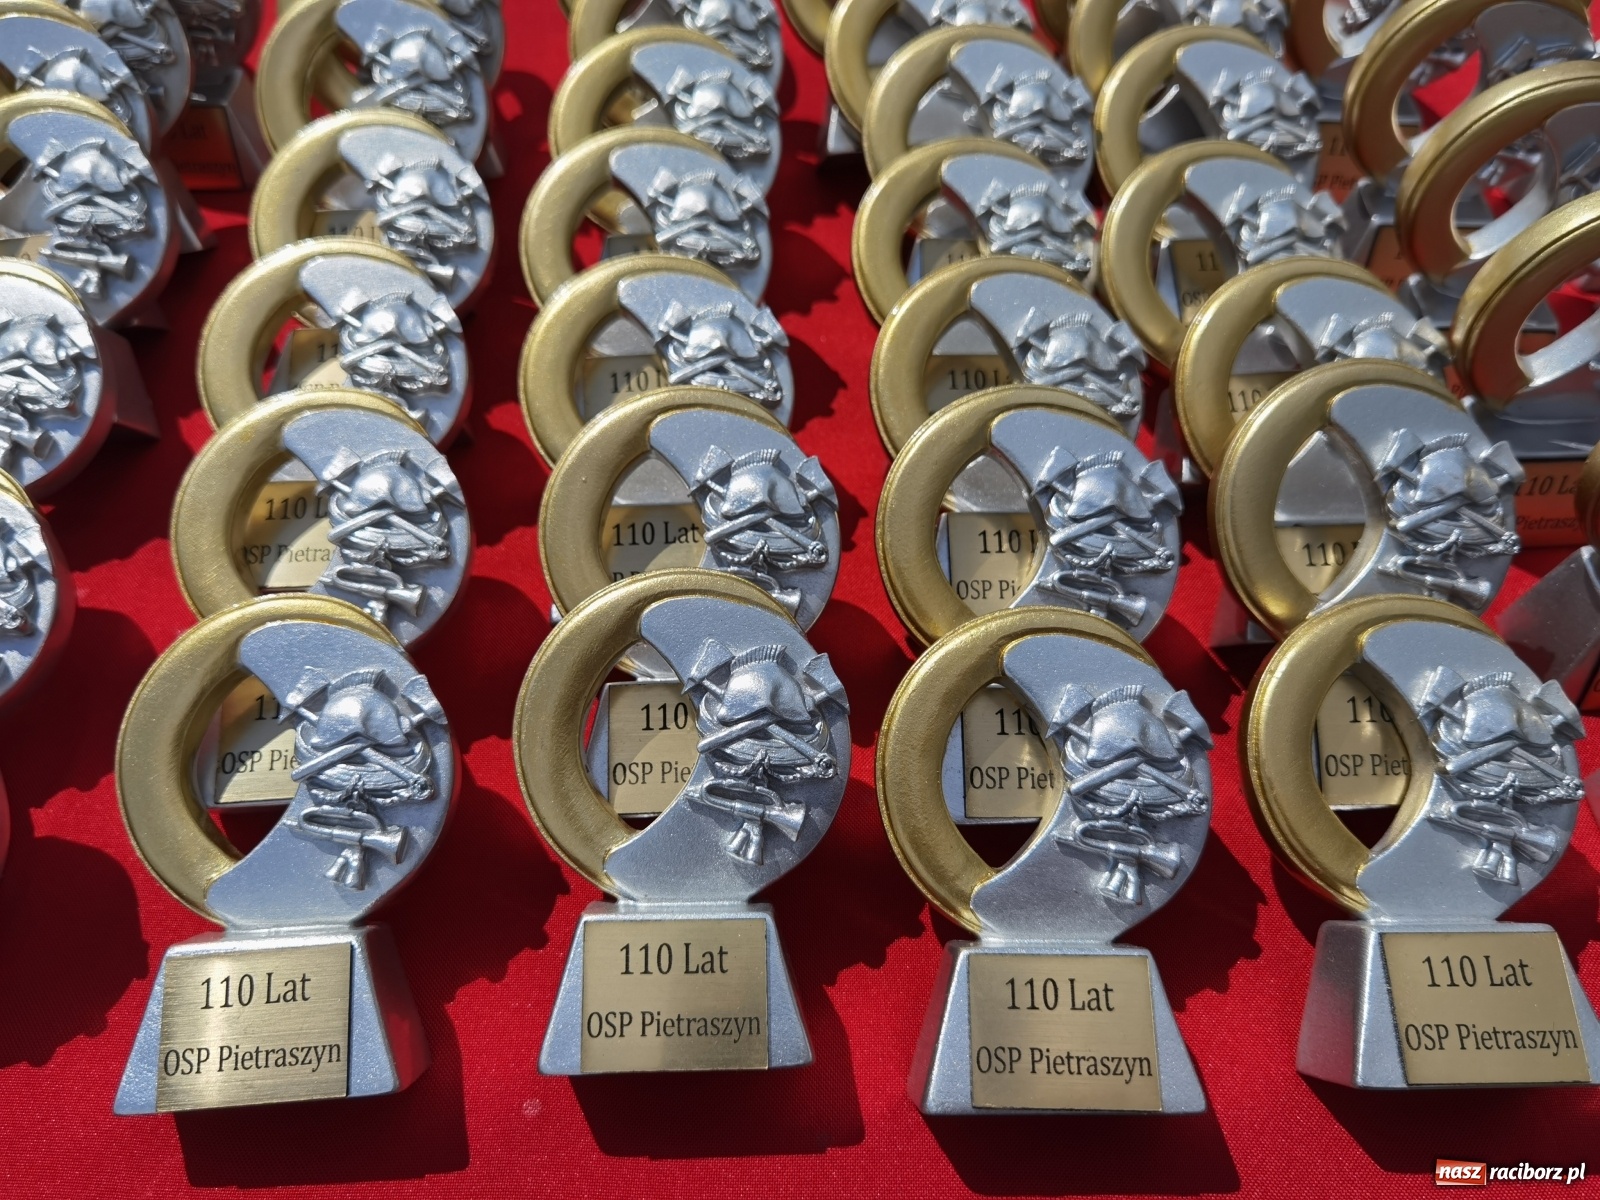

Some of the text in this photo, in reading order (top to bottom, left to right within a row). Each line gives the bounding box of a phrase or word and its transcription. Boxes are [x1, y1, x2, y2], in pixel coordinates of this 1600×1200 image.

[611, 371, 649, 393] 110
[948, 367, 986, 390] 110
[265, 496, 307, 520] 110
[612, 520, 700, 546] 110 Lat
[978, 529, 1021, 554] 110
[1302, 542, 1345, 567] 110
[956, 579, 1021, 600] OSP Pi
[640, 702, 689, 731] 110
[222, 750, 262, 774] OSP
[612, 762, 653, 786] OSP
[1325, 753, 1410, 777] OSP Piet
[969, 766, 1054, 789] OSP Piet
[620, 942, 728, 975] 110 Lat
[1422, 955, 1533, 987] 110 Lat
[201, 972, 312, 1010] 110 Lat
[1005, 977, 1115, 1012] 110 Lat
[586, 1010, 761, 1044] OSP Pietraszyn
[1404, 1023, 1579, 1057] OSP Pietraszyn
[164, 1043, 342, 1077] OSP Pietraszyn
[976, 1046, 1153, 1085] OSP Pietraszyn
